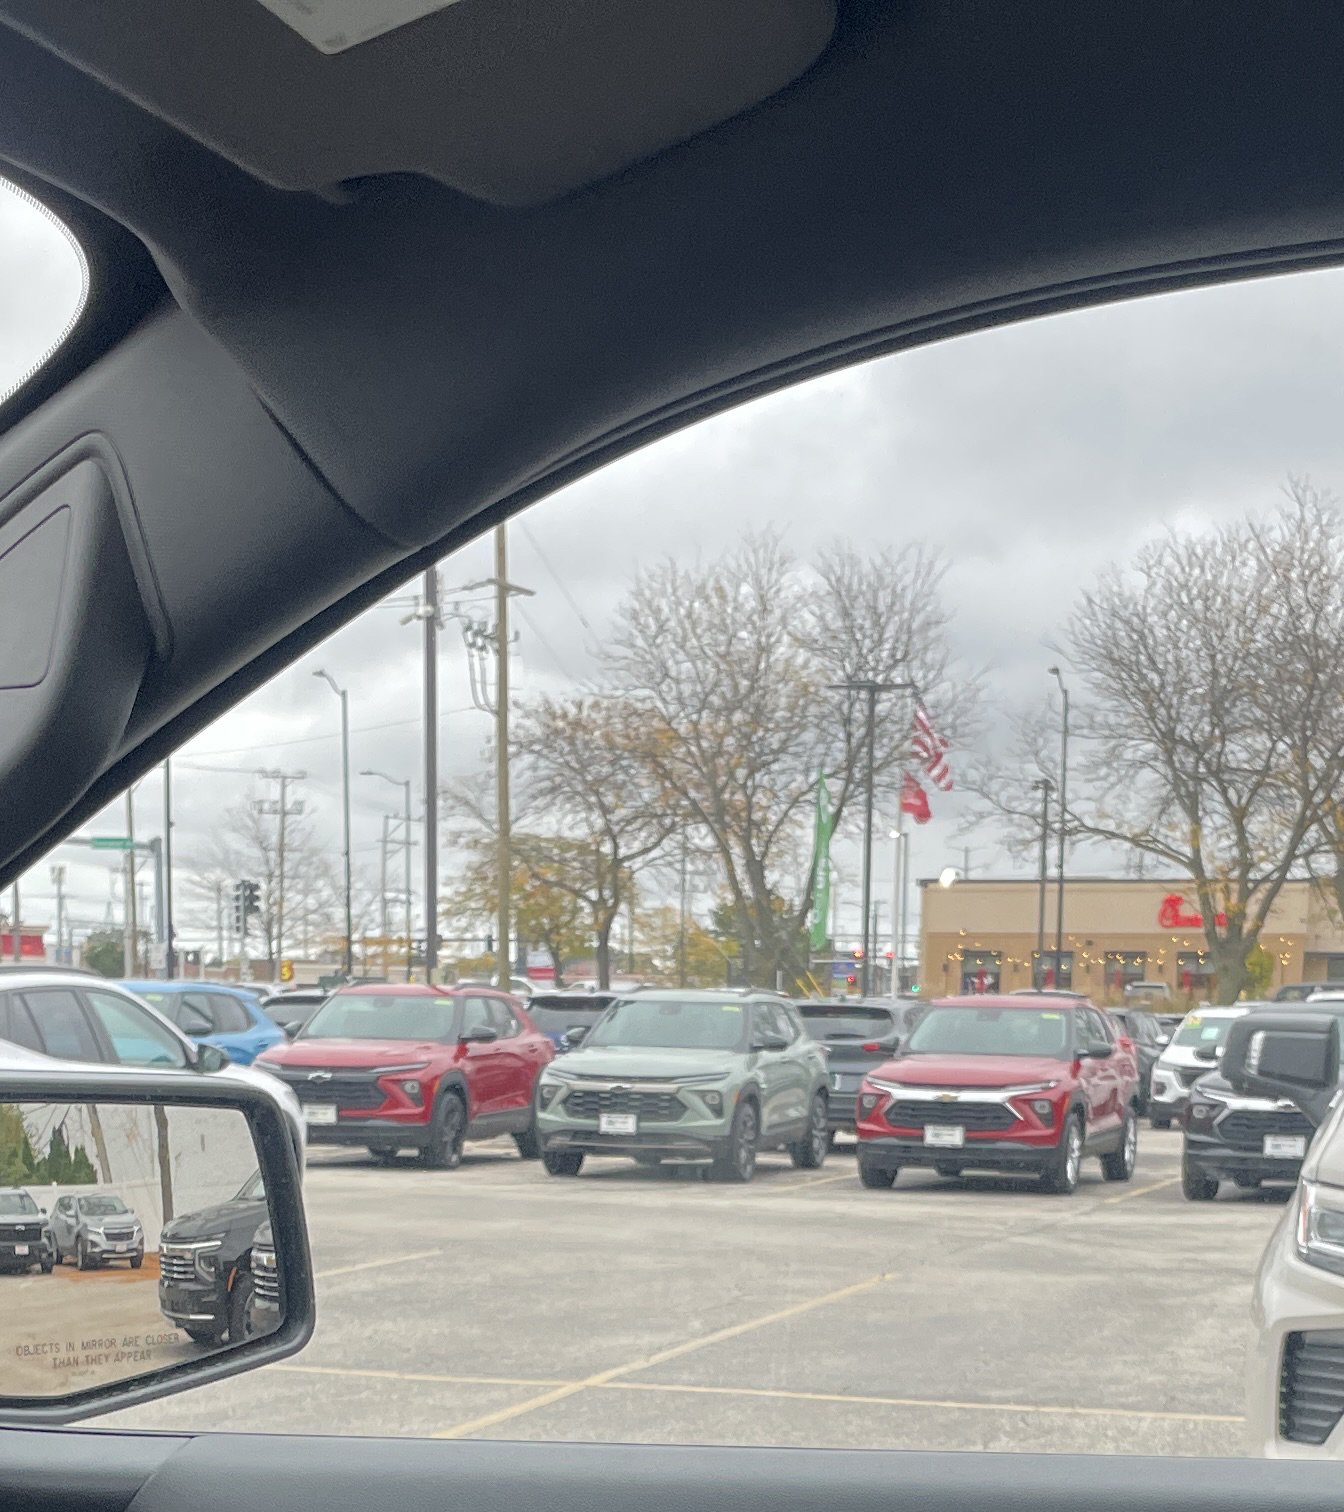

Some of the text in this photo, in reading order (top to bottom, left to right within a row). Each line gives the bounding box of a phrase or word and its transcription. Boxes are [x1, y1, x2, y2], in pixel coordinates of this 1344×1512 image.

[15, 1332, 180, 1356] OBJECTS IN MIRROR ARE CLOSER
[52, 1349, 152, 1369] THAN THEY APPEAR
